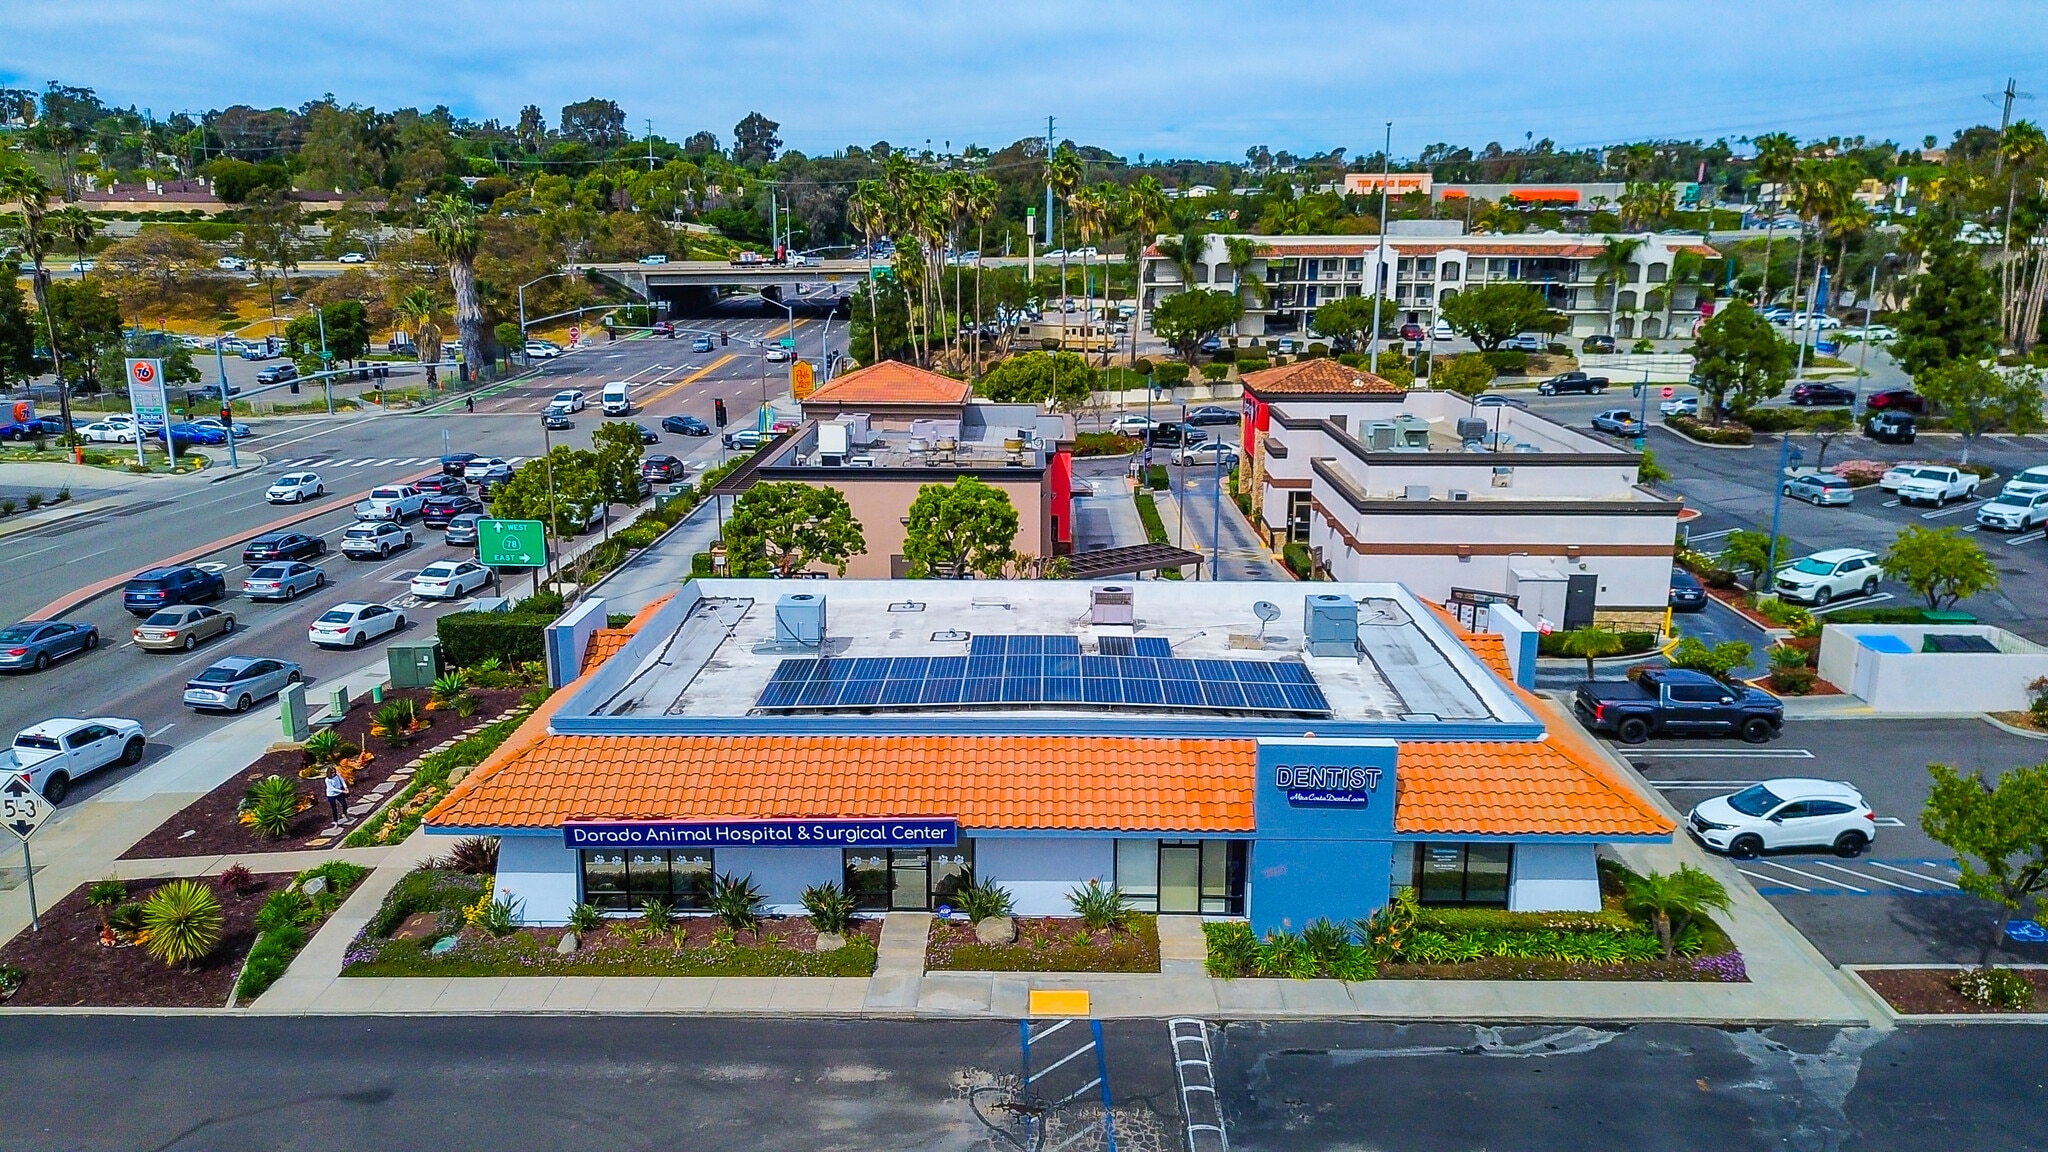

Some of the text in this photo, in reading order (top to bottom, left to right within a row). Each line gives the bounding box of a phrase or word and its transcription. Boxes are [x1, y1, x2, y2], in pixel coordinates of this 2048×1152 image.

[136, 367, 150, 378] 76
[1276, 766, 1383, 789] DENTIST
[0, 799, 43, 818] 5'-3"
[573, 825, 948, 844] Dorado Animal Hospital & Surgical Center
